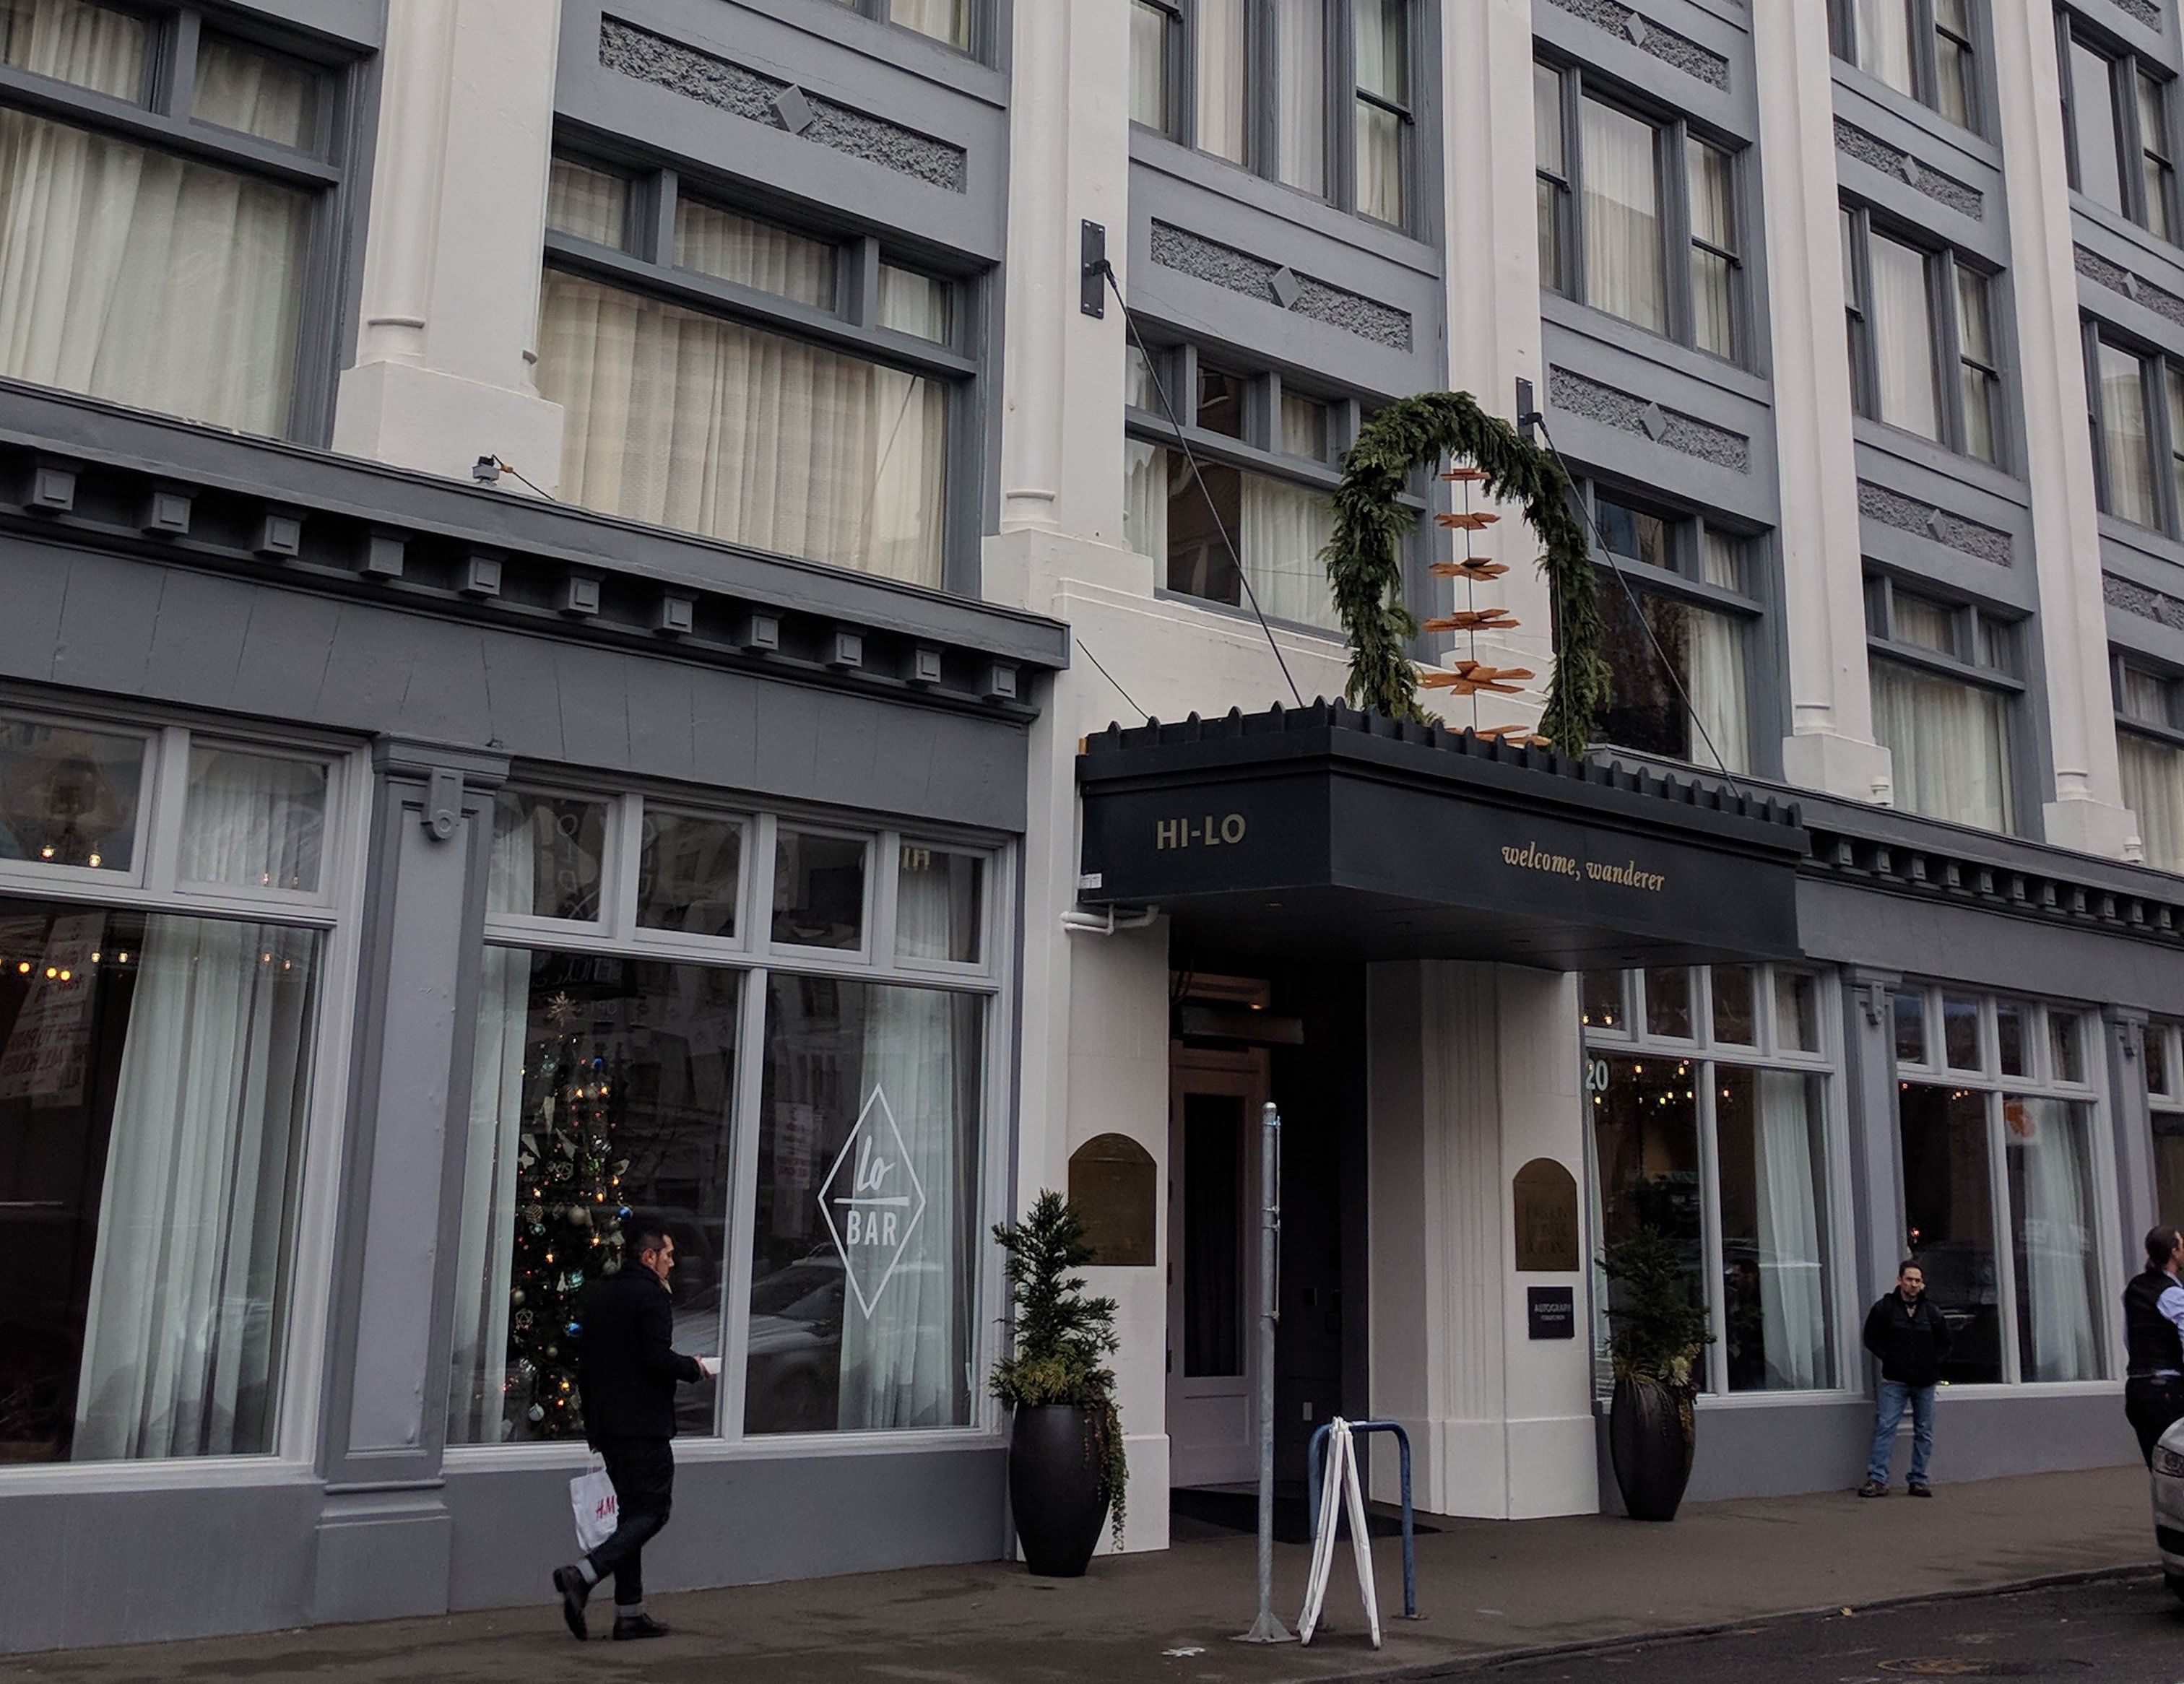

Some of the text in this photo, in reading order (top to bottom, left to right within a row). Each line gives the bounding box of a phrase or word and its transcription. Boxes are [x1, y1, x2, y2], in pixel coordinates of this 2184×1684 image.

[1157, 814, 1245, 849] HI-LO
[1502, 841, 1665, 891] welcome, wanderer
[846, 1210, 898, 1246] BAR
